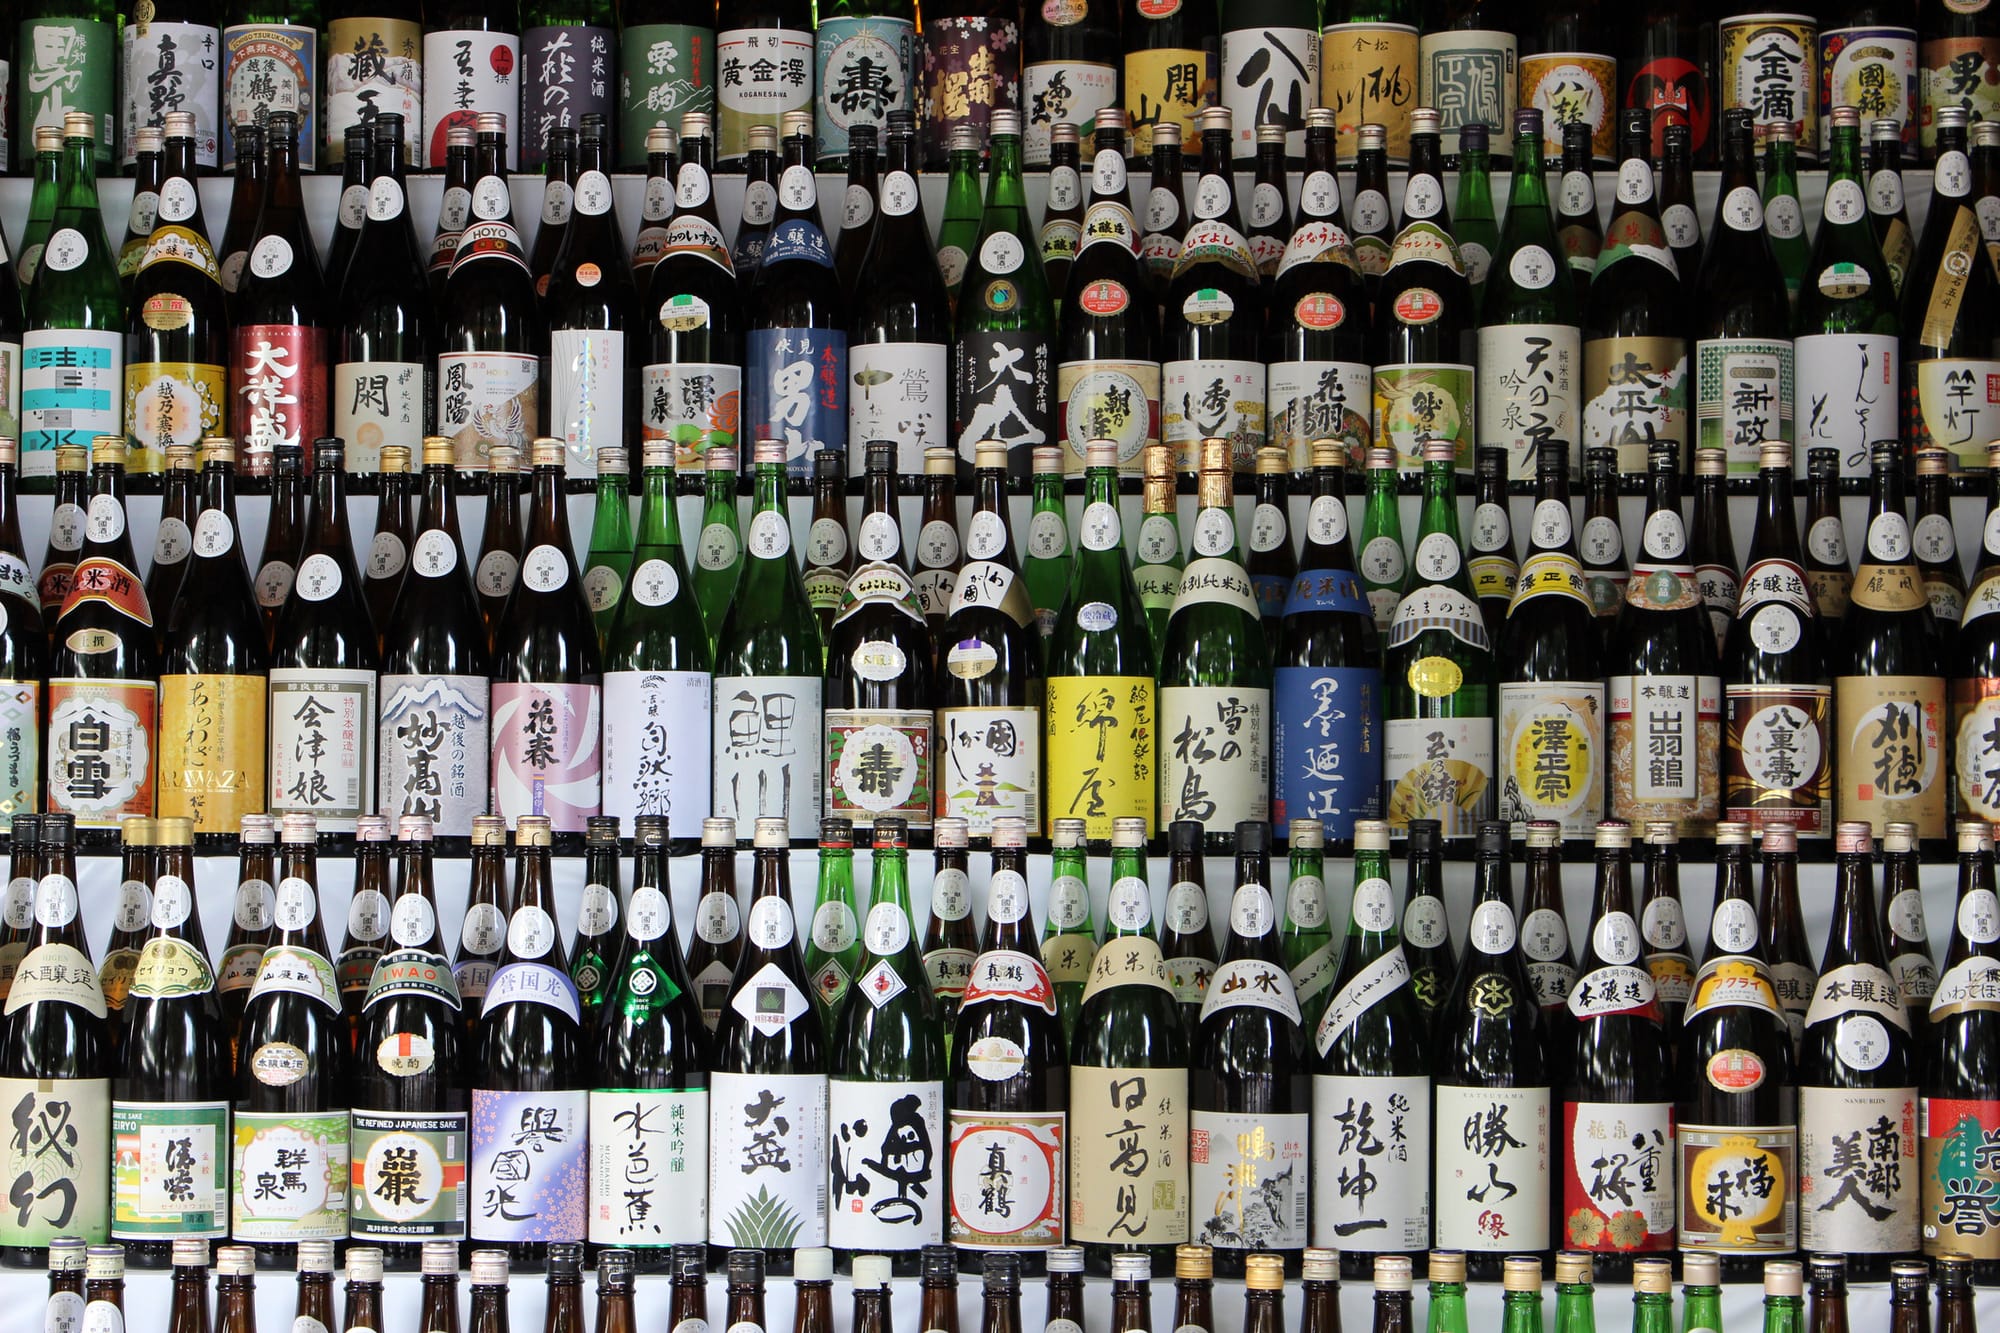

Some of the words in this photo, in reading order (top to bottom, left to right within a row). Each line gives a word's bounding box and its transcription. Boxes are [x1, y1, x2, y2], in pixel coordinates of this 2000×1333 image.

[201, 34, 215, 71] 辛口
[747, 36, 782, 49] 飛切
[247, 59, 277, 73] 越後
[591, 36, 608, 98] 純米酒
[1743, 42, 1802, 120] 金滴
[739, 91, 787, 99] KOGANESAWA
[472, 227, 507, 241] HOYO
[770, 226, 826, 248] 本醸造
[1086, 220, 1126, 237] 本醸造
[1187, 229, 1235, 249] ひでよし
[1832, 286, 1856, 295] 上撰
[673, 316, 697, 327] 上撰
[775, 338, 815, 356] 伏見
[820, 343, 839, 411] 本醸造
[1034, 343, 1049, 414] 特別純米酒
[156, 382, 175, 449] 越乃寒梅
[1499, 368, 1527, 432] 吟泉
[1607, 352, 1662, 448] 太平山
[1731, 382, 1774, 447] 新政
[1178, 573, 1250, 599] 特別純米酒
[1520, 571, 1583, 592] 澤正宗
[1747, 574, 1804, 597] 本醸造
[1404, 598, 1472, 619] たまのお
[957, 662, 984, 674] 上撰
[1641, 685, 1690, 700] 本醸造
[343, 697, 355, 753] 特別本醸造
[522, 698, 560, 771] 花春
[1249, 702, 1262, 773] 特別純米酒
[67, 713, 109, 800] 白雪
[288, 696, 336, 806] 会津娘
[449, 713, 465, 801] 越後の銘酒
[1069, 685, 1119, 817] 綿屋
[1531, 719, 1572, 802] 澤正宗
[1648, 711, 1684, 788] 出羽鶴
[17, 965, 94, 990] 本醸造
[383, 966, 438, 984] IWAO
[500, 971, 561, 996] 誉国光
[987, 964, 1025, 984] 真鶴
[1097, 952, 1165, 983] 純米酒
[1222, 971, 1282, 996] 山水
[1711, 975, 1761, 991] フクライ
[1578, 977, 1646, 1008] 本醸造
[1824, 979, 1901, 1010] 本醸造
[1463, 1092, 1525, 1100] KATSUYAMA
[365, 1119, 394, 1128] REFINED
[395, 1119, 438, 1129] JAPANESE
[439, 1119, 457, 1129] SAKE
[670, 1103, 685, 1173] 純米吟醸
[1156, 1097, 1174, 1169] 純米酒
[1387, 1093, 1410, 1163] 純米酒
[613, 1102, 665, 1236] 水芭蕉
[1333, 1097, 1388, 1237] 乾坤一
[1463, 1102, 1527, 1203] 勝山
[1865, 1114, 1901, 1200] 南部
[978, 1141, 1016, 1219] 真鶴
[1816, 1130, 1898, 1222] 美人
